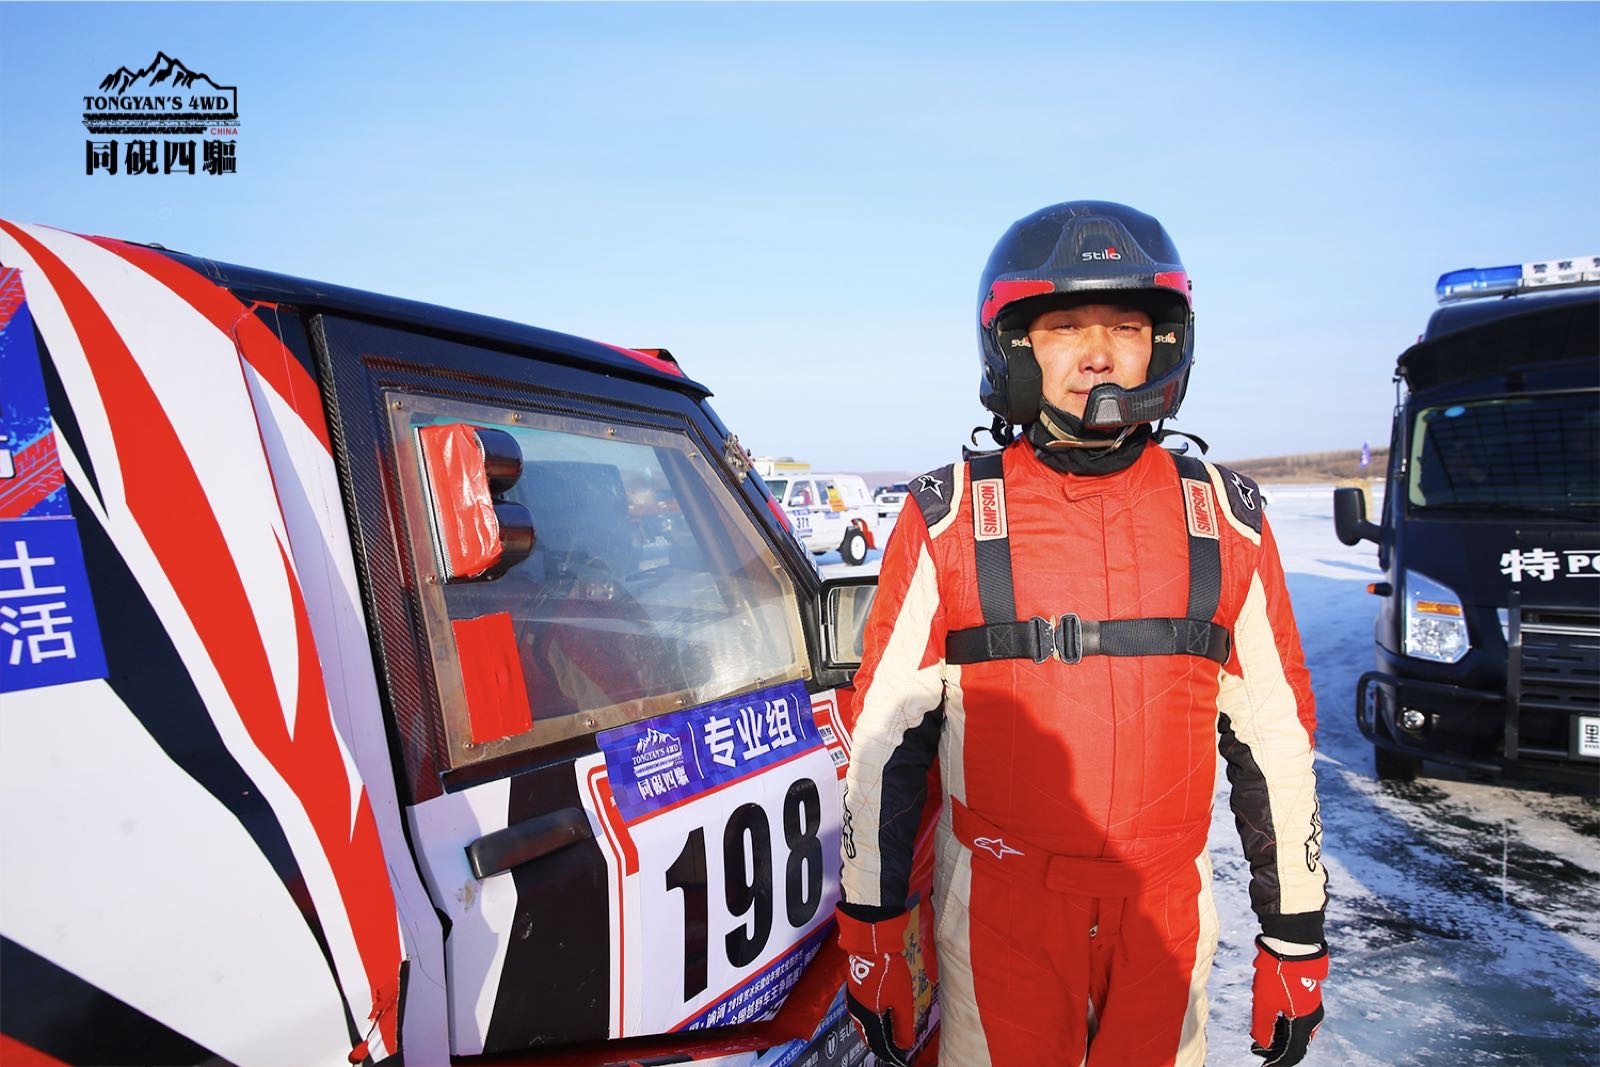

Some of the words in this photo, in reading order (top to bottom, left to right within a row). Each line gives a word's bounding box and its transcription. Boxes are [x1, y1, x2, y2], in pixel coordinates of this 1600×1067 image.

[796, 517, 809, 529] 371
[981, 485, 997, 533] SIMPSON
[1190, 485, 1211, 532] SIMPSON
[1500, 548, 1560, 582] 特
[0, 602, 77, 666] 活
[704, 698, 797, 768] 专业组
[665, 777, 823, 1004] 198
